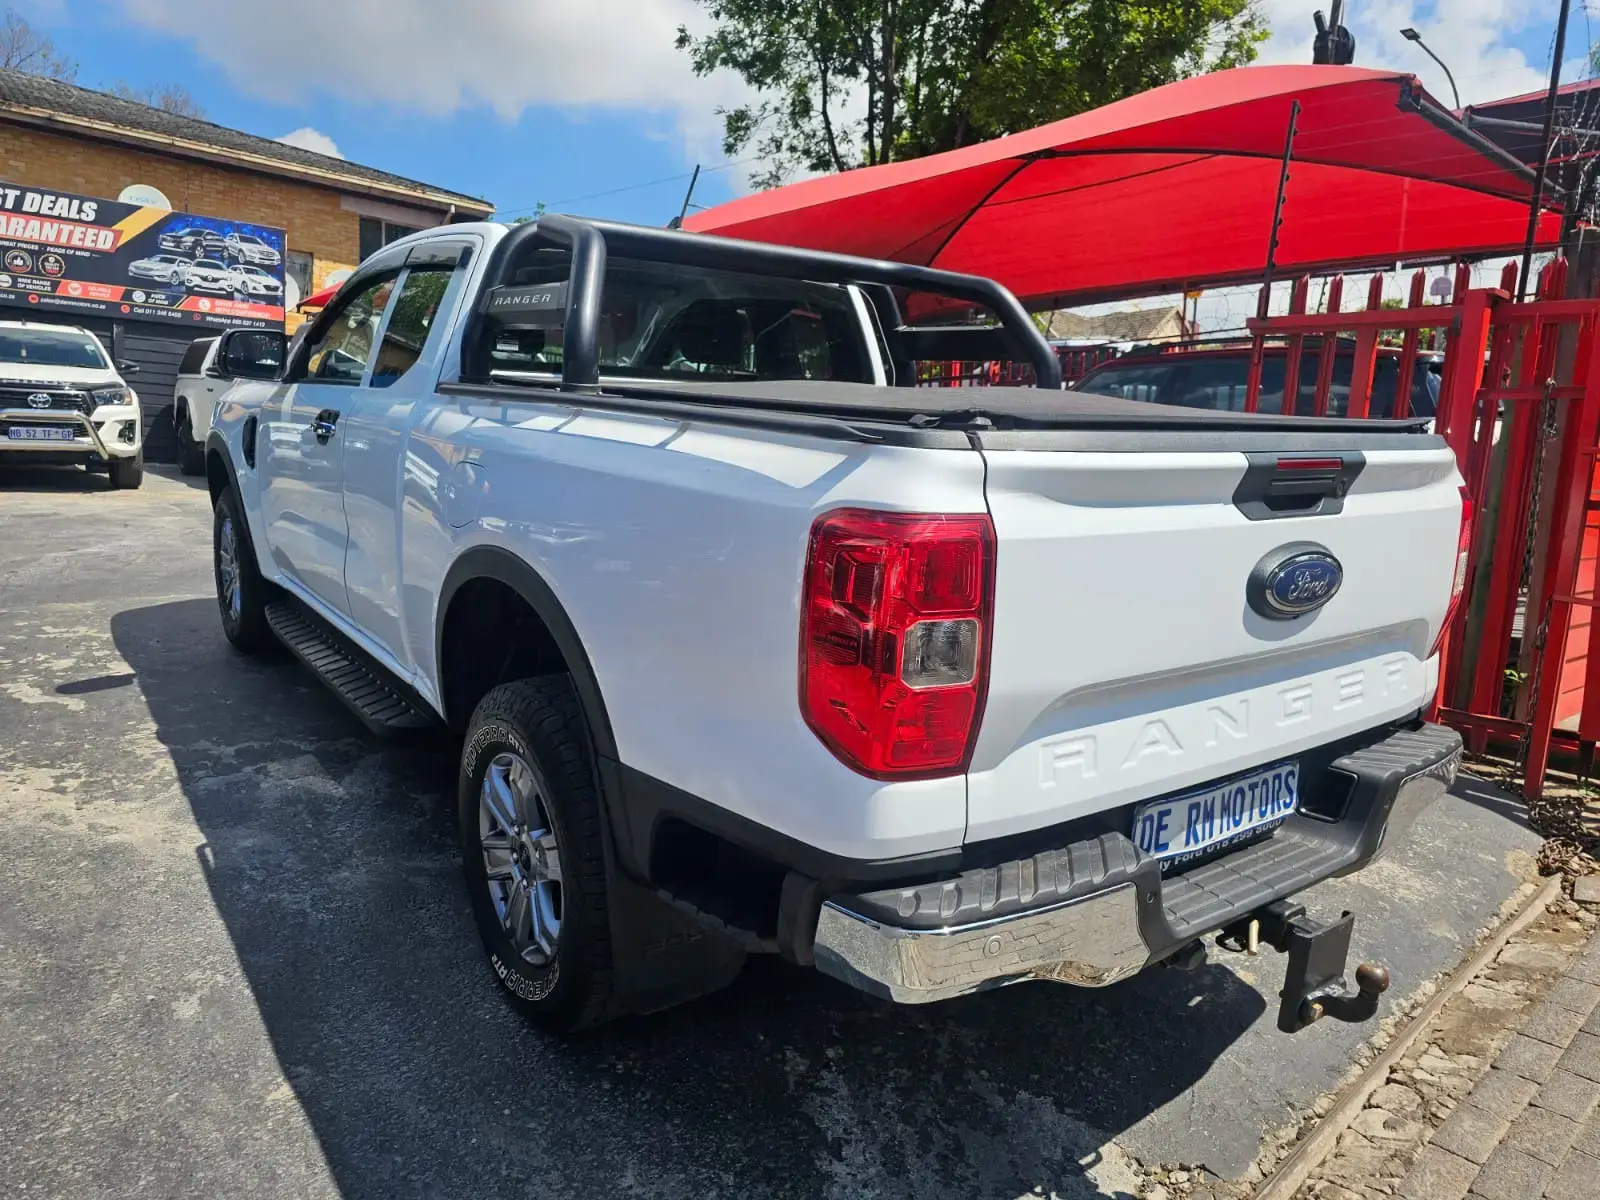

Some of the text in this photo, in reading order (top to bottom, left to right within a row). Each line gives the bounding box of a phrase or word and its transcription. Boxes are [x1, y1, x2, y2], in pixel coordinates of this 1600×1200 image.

[0, 187, 98, 222] T DEALS
[133, 306, 145, 314] Call
[494, 293, 552, 306] RANGER
[205, 315, 232, 325] WhatsApp
[25, 429, 38, 438] 52
[61, 430, 72, 440] GP
[1288, 568, 1331, 601] Ford
[1038, 655, 1409, 790] RANGER
[1219, 769, 1297, 835] MOTORS
[1159, 859, 1171, 872] ly
[1174, 850, 1203, 866] Ford
